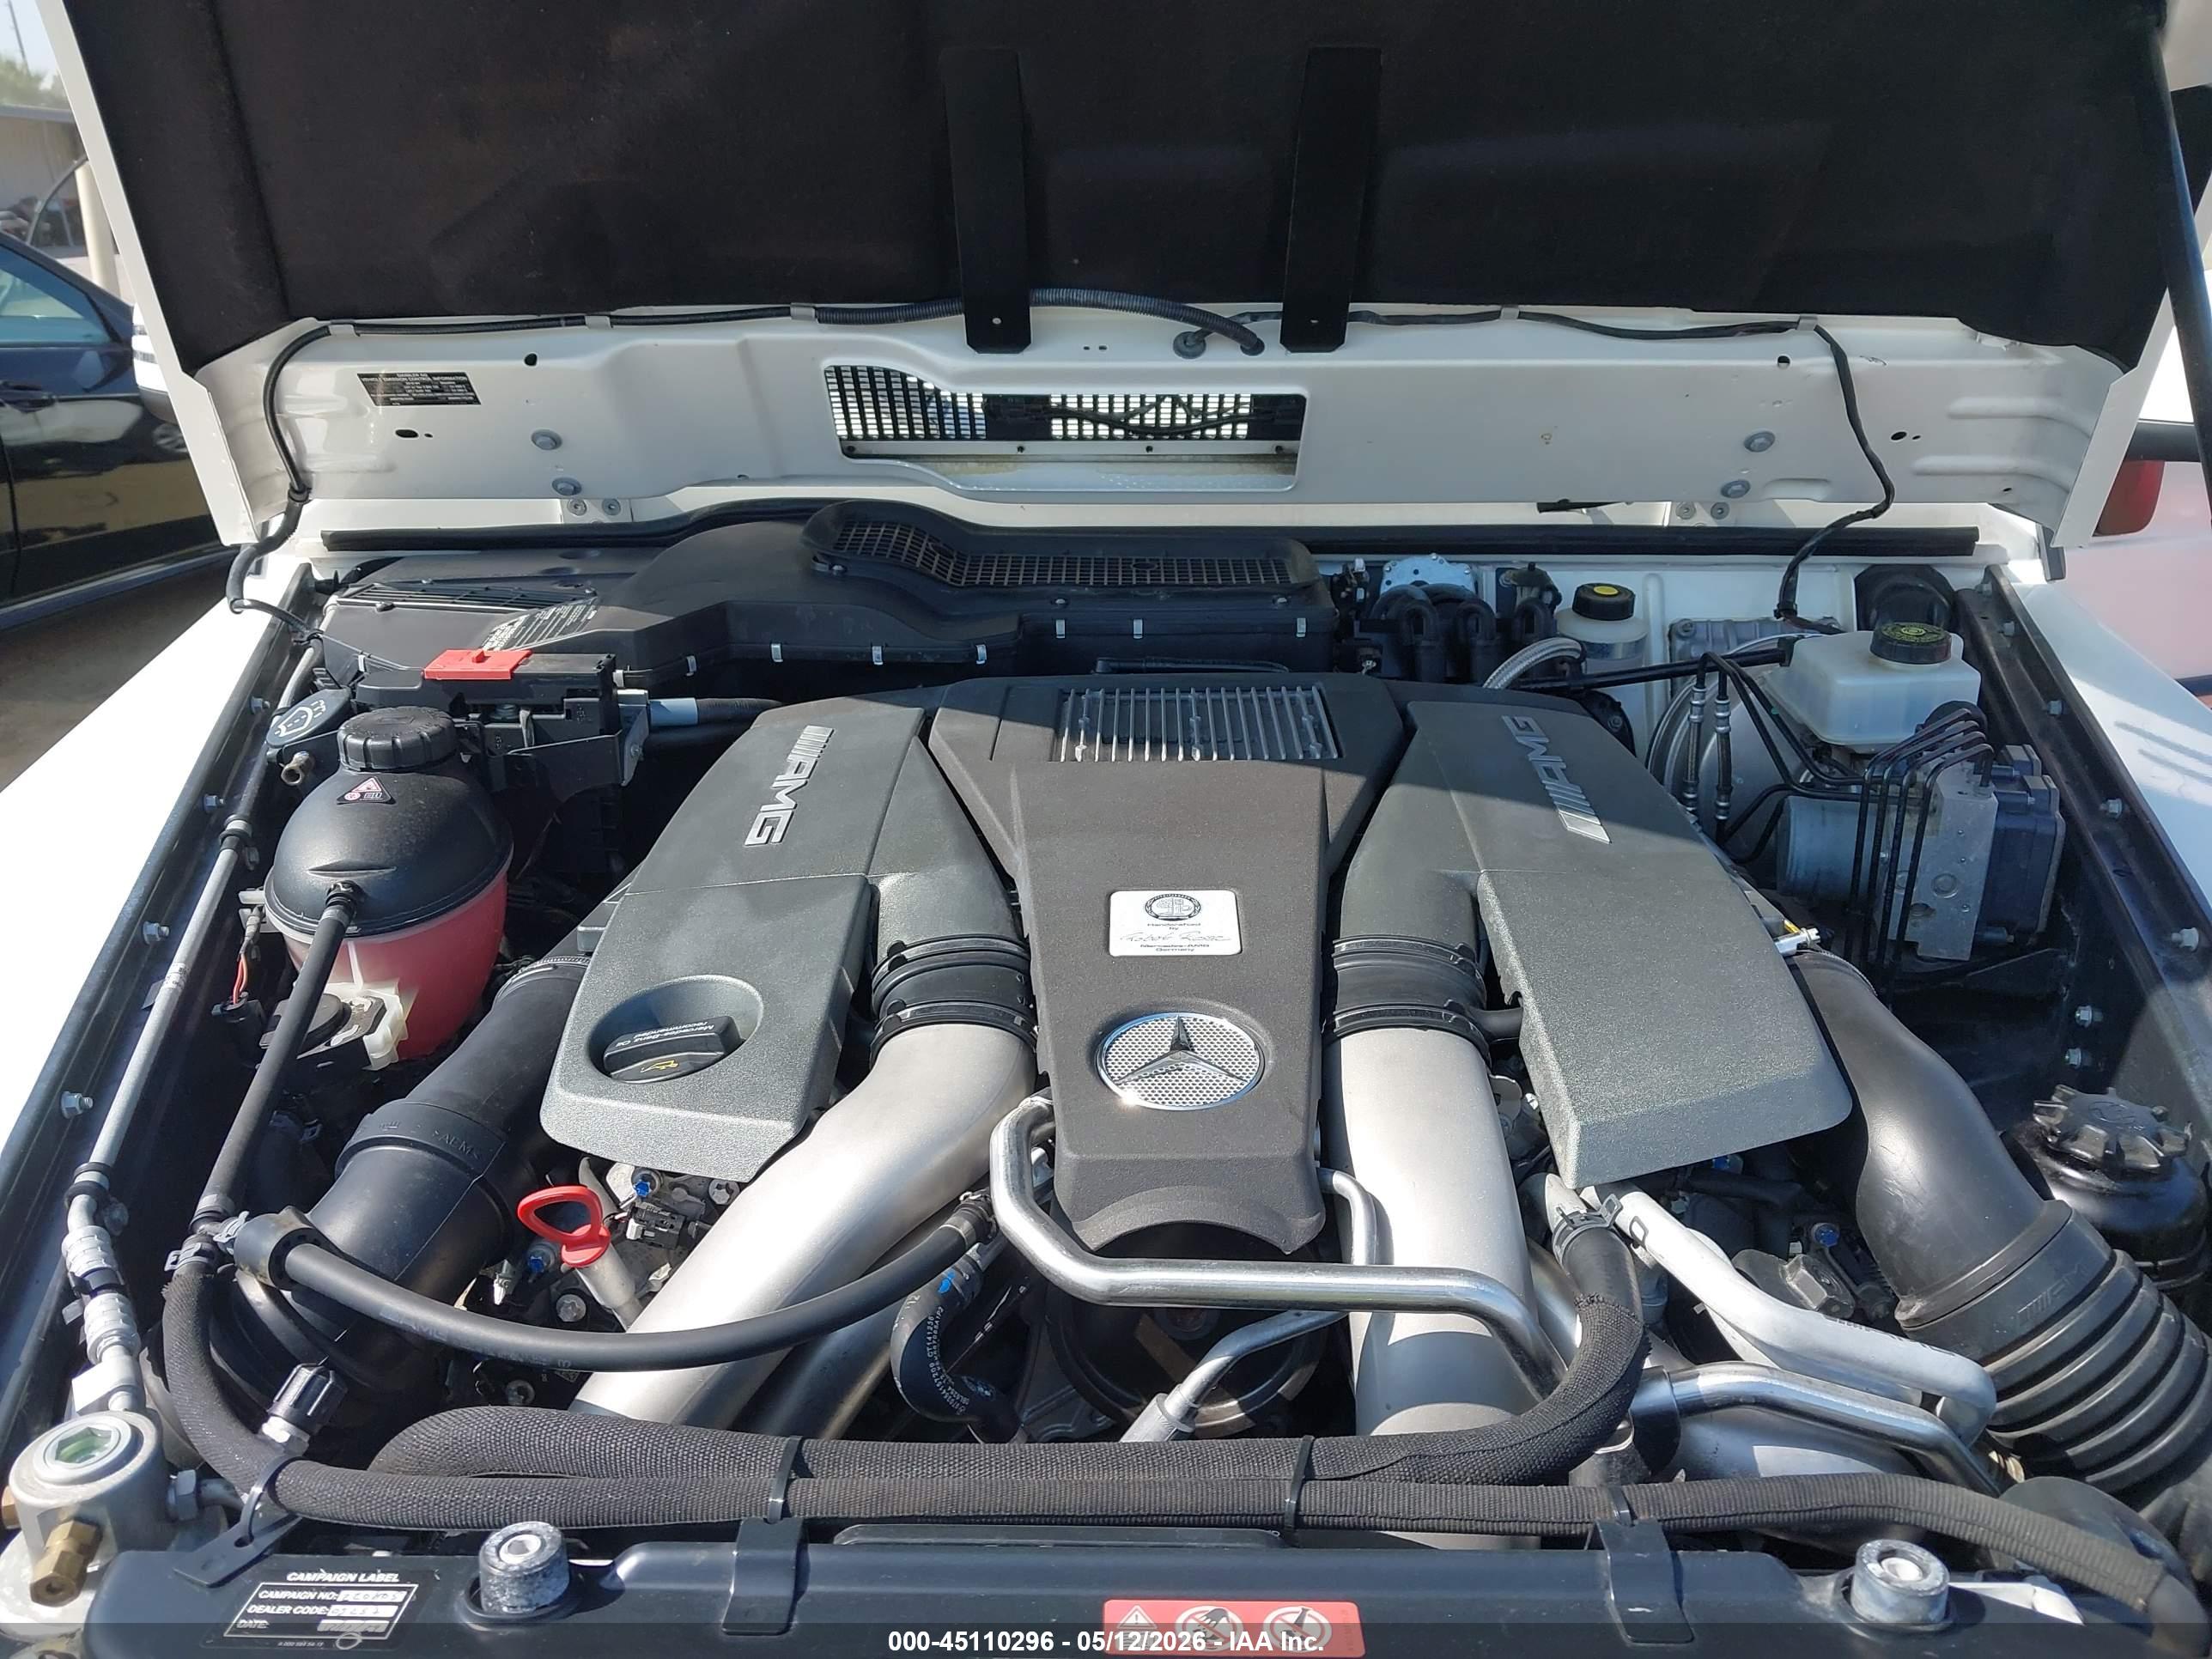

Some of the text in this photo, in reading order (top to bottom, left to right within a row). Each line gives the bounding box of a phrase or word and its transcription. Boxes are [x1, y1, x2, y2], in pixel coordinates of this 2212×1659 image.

[1502, 715, 1587, 802] AMG
[744, 750, 819, 847] AMG
[633, 1021, 708, 1039] recommended
[633, 1024, 715, 1043] Mercedes-Benz
[287, 1571, 400, 1583] CAMPAIGN LABEL
[258, 1589, 337, 1601] CAMPAIGN NO:
[246, 1604, 330, 1614] DEALER CODE:
[236, 1620, 270, 1629] DATE:
